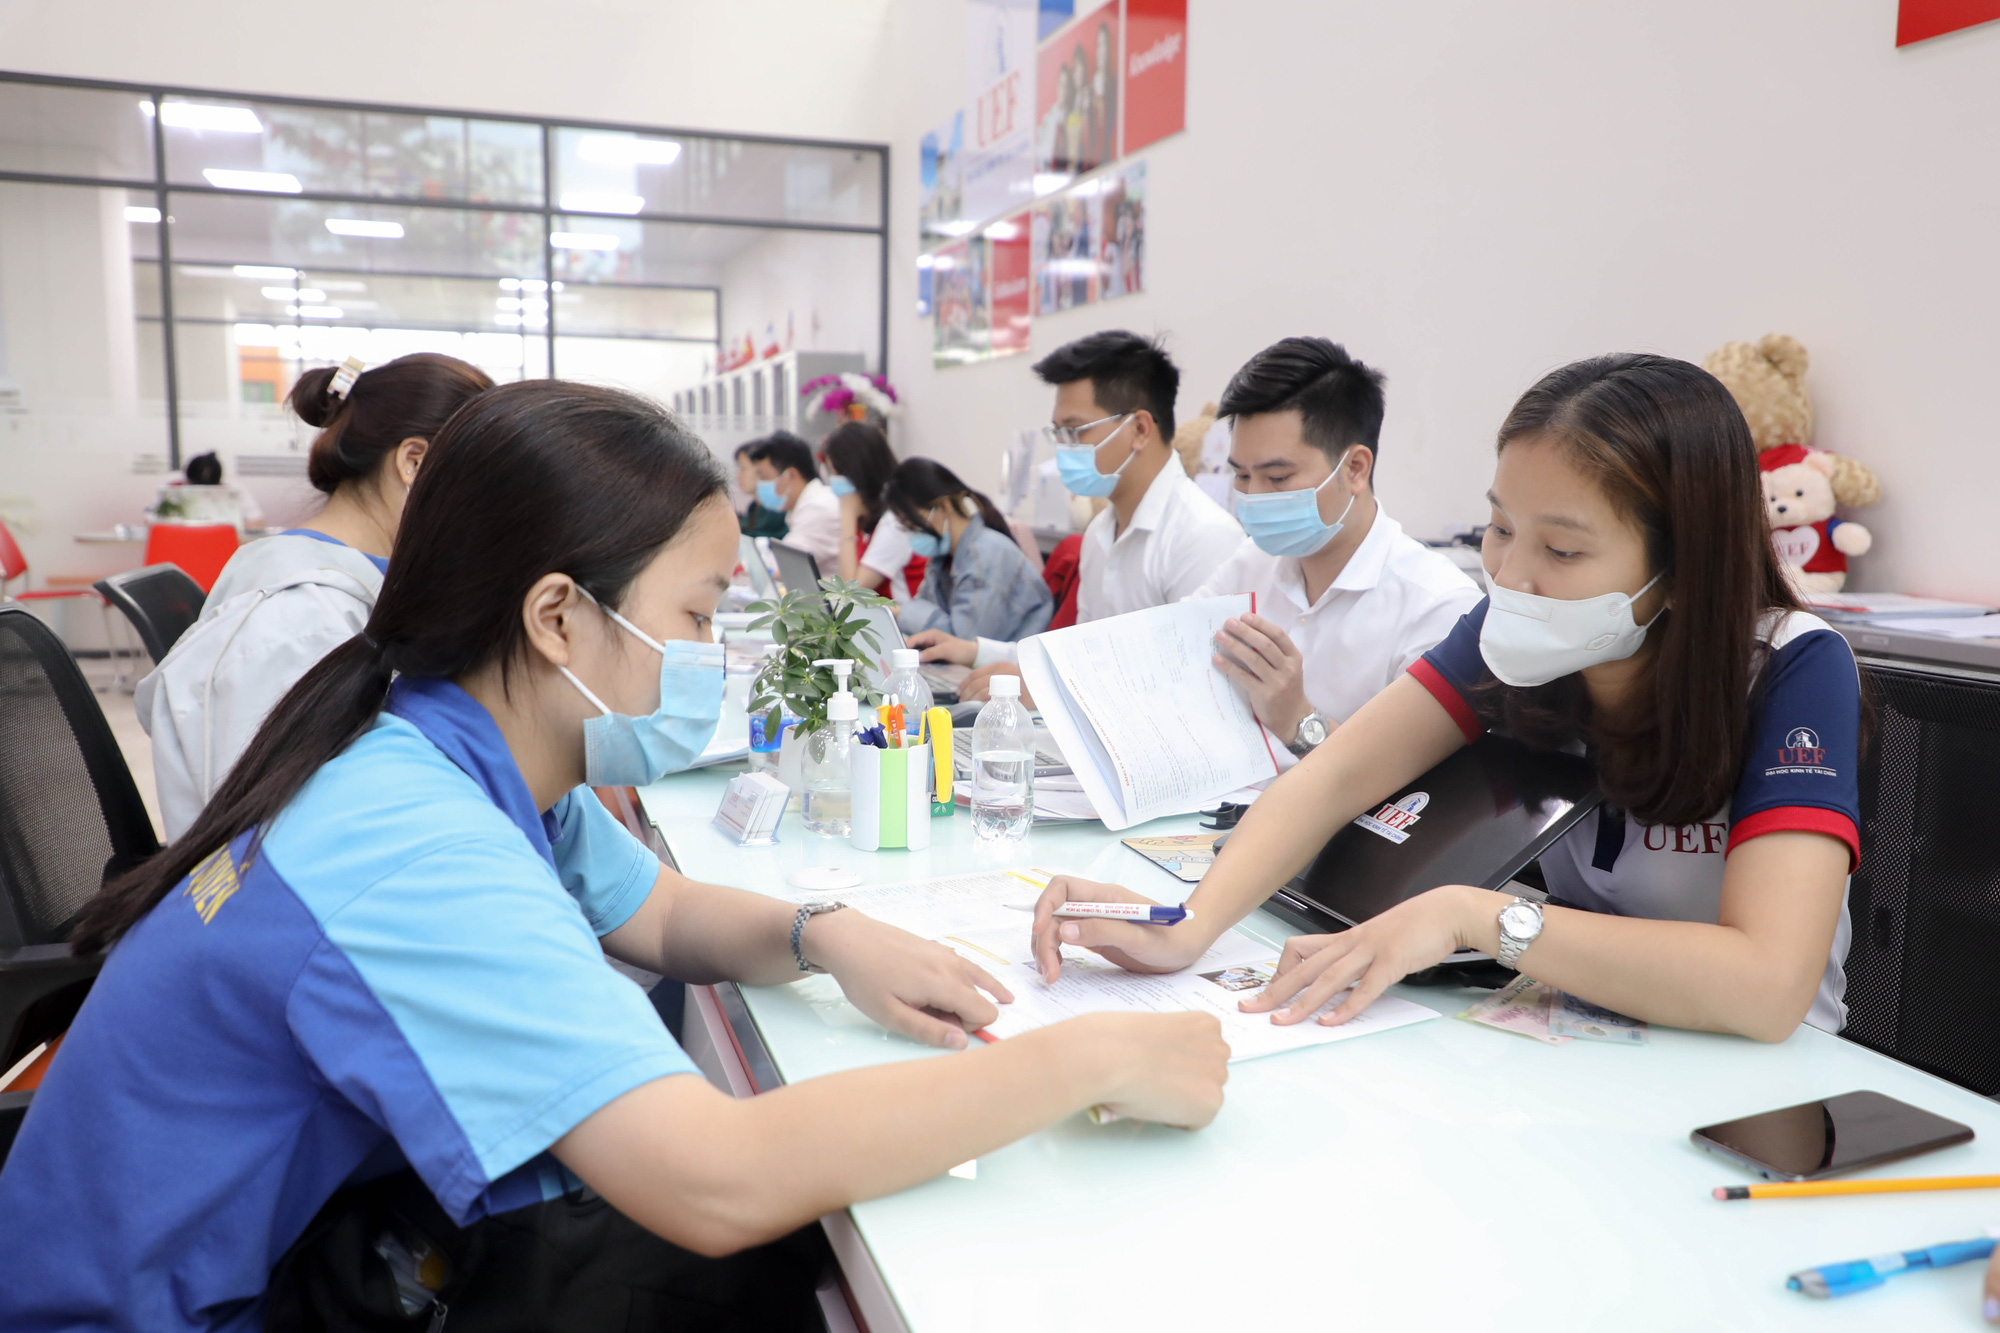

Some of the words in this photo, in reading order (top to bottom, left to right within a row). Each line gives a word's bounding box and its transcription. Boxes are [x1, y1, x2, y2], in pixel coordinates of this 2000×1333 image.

[977, 71, 1021, 148] UEF
[1777, 747, 1826, 765] UEF
[1376, 805, 1416, 830] UEF
[1643, 822, 1727, 854] UEF
